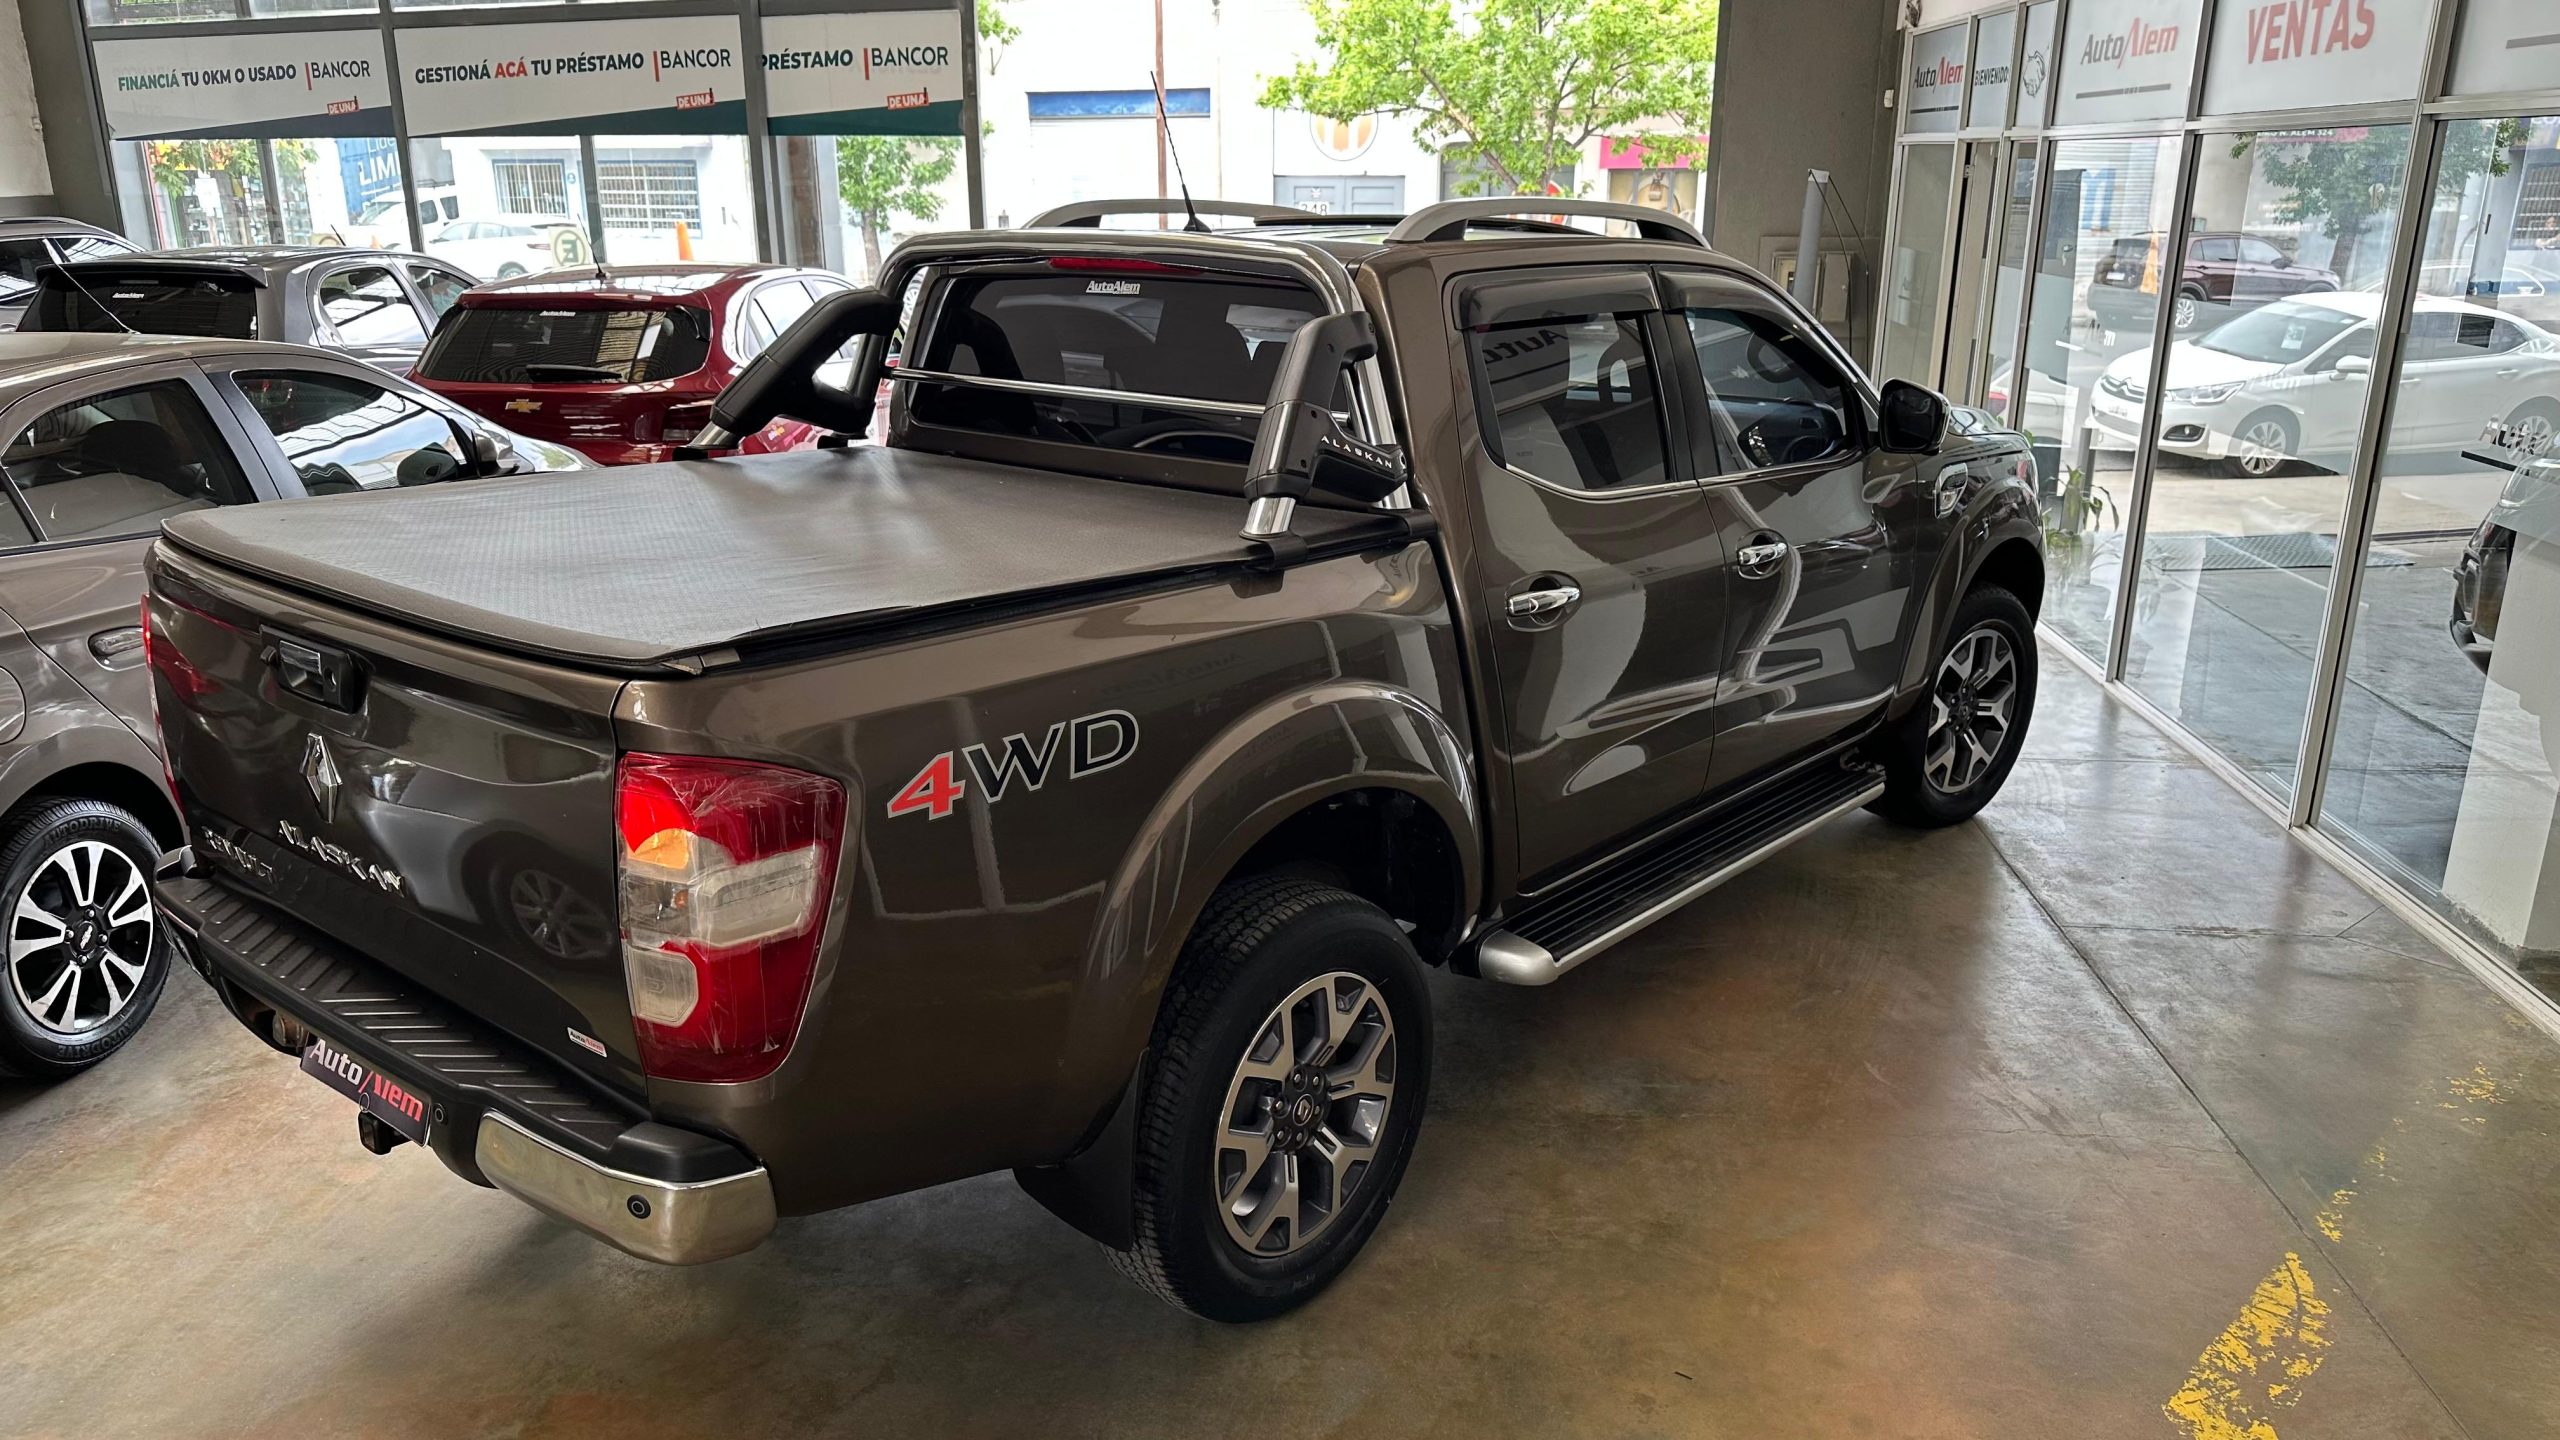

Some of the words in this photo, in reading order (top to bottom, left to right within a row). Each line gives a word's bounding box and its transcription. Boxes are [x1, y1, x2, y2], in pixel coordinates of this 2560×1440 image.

[2248, 0, 2376, 64] VENTAS
[661, 48, 732, 69] BANCOR
[871, 46, 949, 67] BANCOR
[118, 69, 179, 91] FINANCIÁ
[182, 72, 199, 87] TU
[234, 68, 245, 83] O
[248, 64, 297, 82] USADO
[311, 60, 371, 79] BANCOR
[415, 59, 491, 84] GESTIONÁ
[494, 57, 528, 79] ACÁ
[531, 59, 551, 76] TU
[556, 52, 645, 75] PRÉSTAMO
[329, 103, 340, 115] DE
[678, 97, 690, 109] DE
[889, 97, 902, 108] DE
[1321, 435, 1392, 469] ALASKAN
[887, 709, 1140, 820] 4WD
